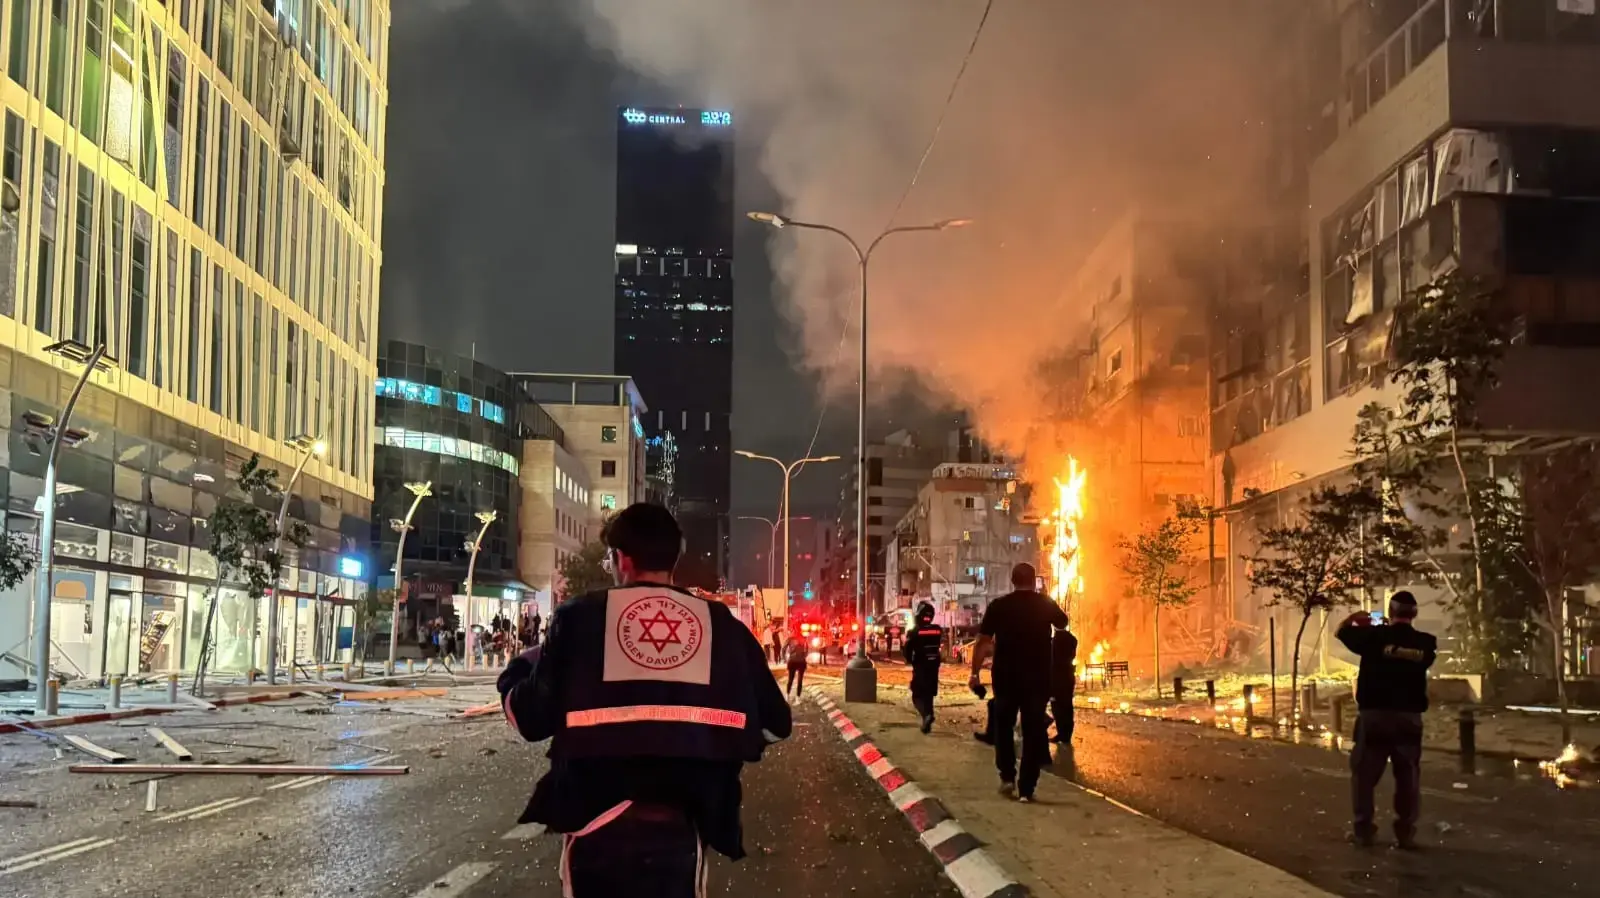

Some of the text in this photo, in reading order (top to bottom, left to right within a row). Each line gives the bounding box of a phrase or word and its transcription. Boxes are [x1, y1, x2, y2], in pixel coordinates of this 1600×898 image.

[649, 115, 685, 124] CENTRAL
[626, 600, 695, 625] מגן דוד אדום
[623, 625, 697, 665] MAGEN DAVID ADOM
